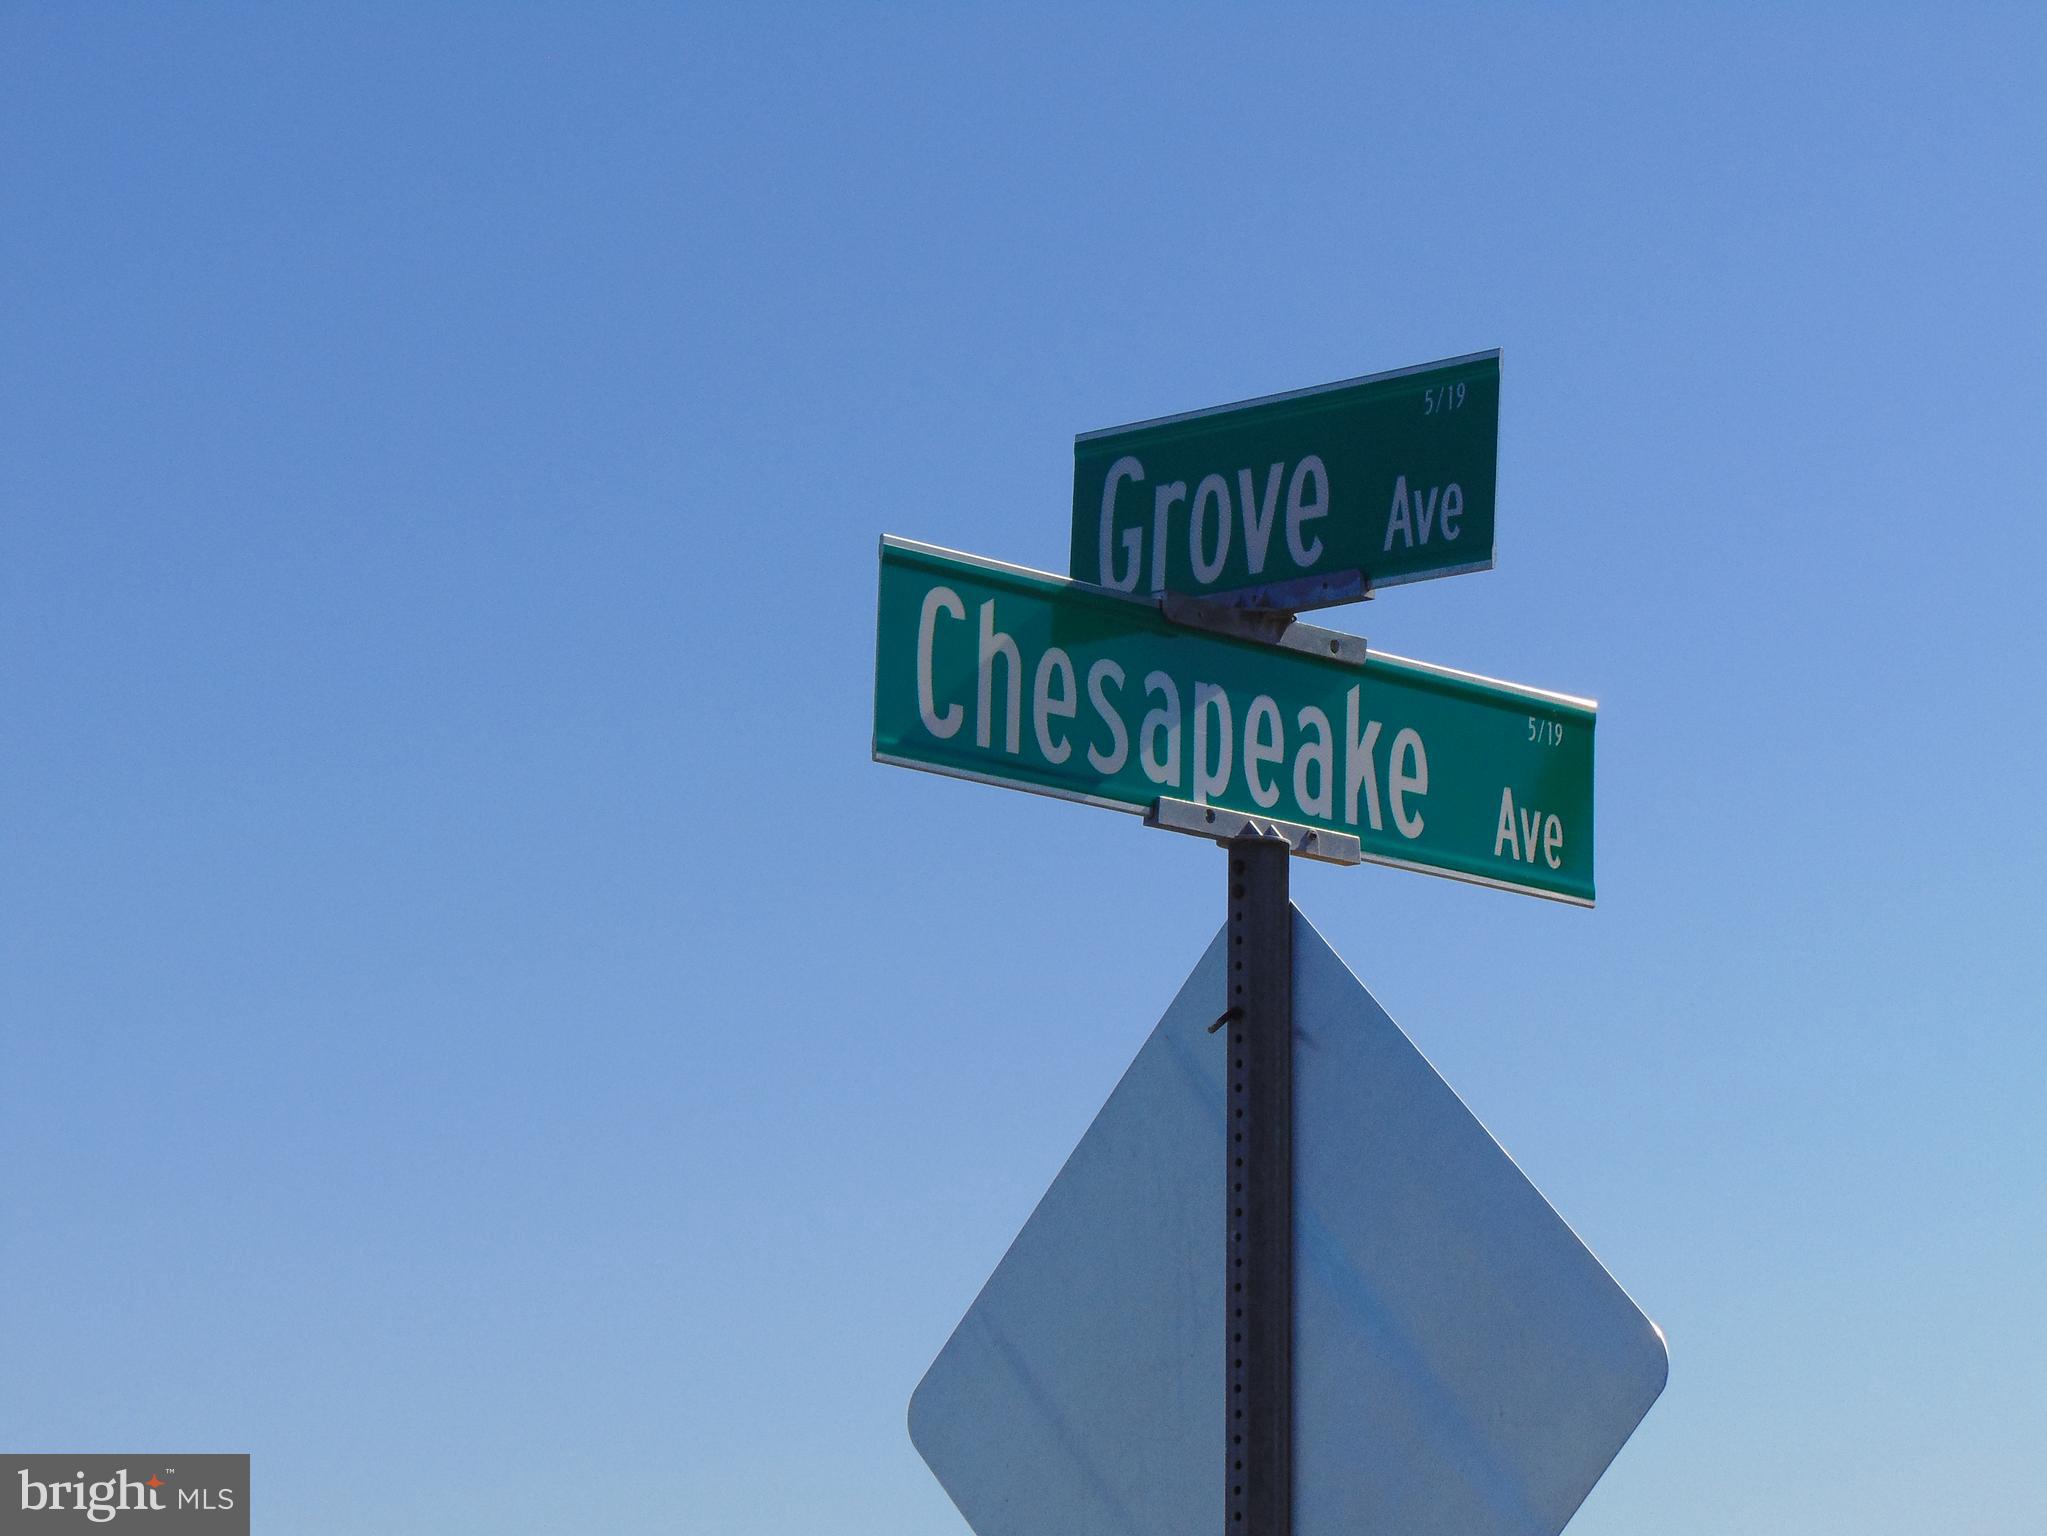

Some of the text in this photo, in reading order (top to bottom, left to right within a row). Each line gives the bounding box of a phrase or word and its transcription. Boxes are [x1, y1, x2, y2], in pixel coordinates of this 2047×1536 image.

[1424, 382, 1466, 416] 5/19
[1100, 454, 1464, 594] Grove Ave
[916, 586, 1564, 869] Chesapeake Ave
[1527, 716, 1564, 747] 5/19
